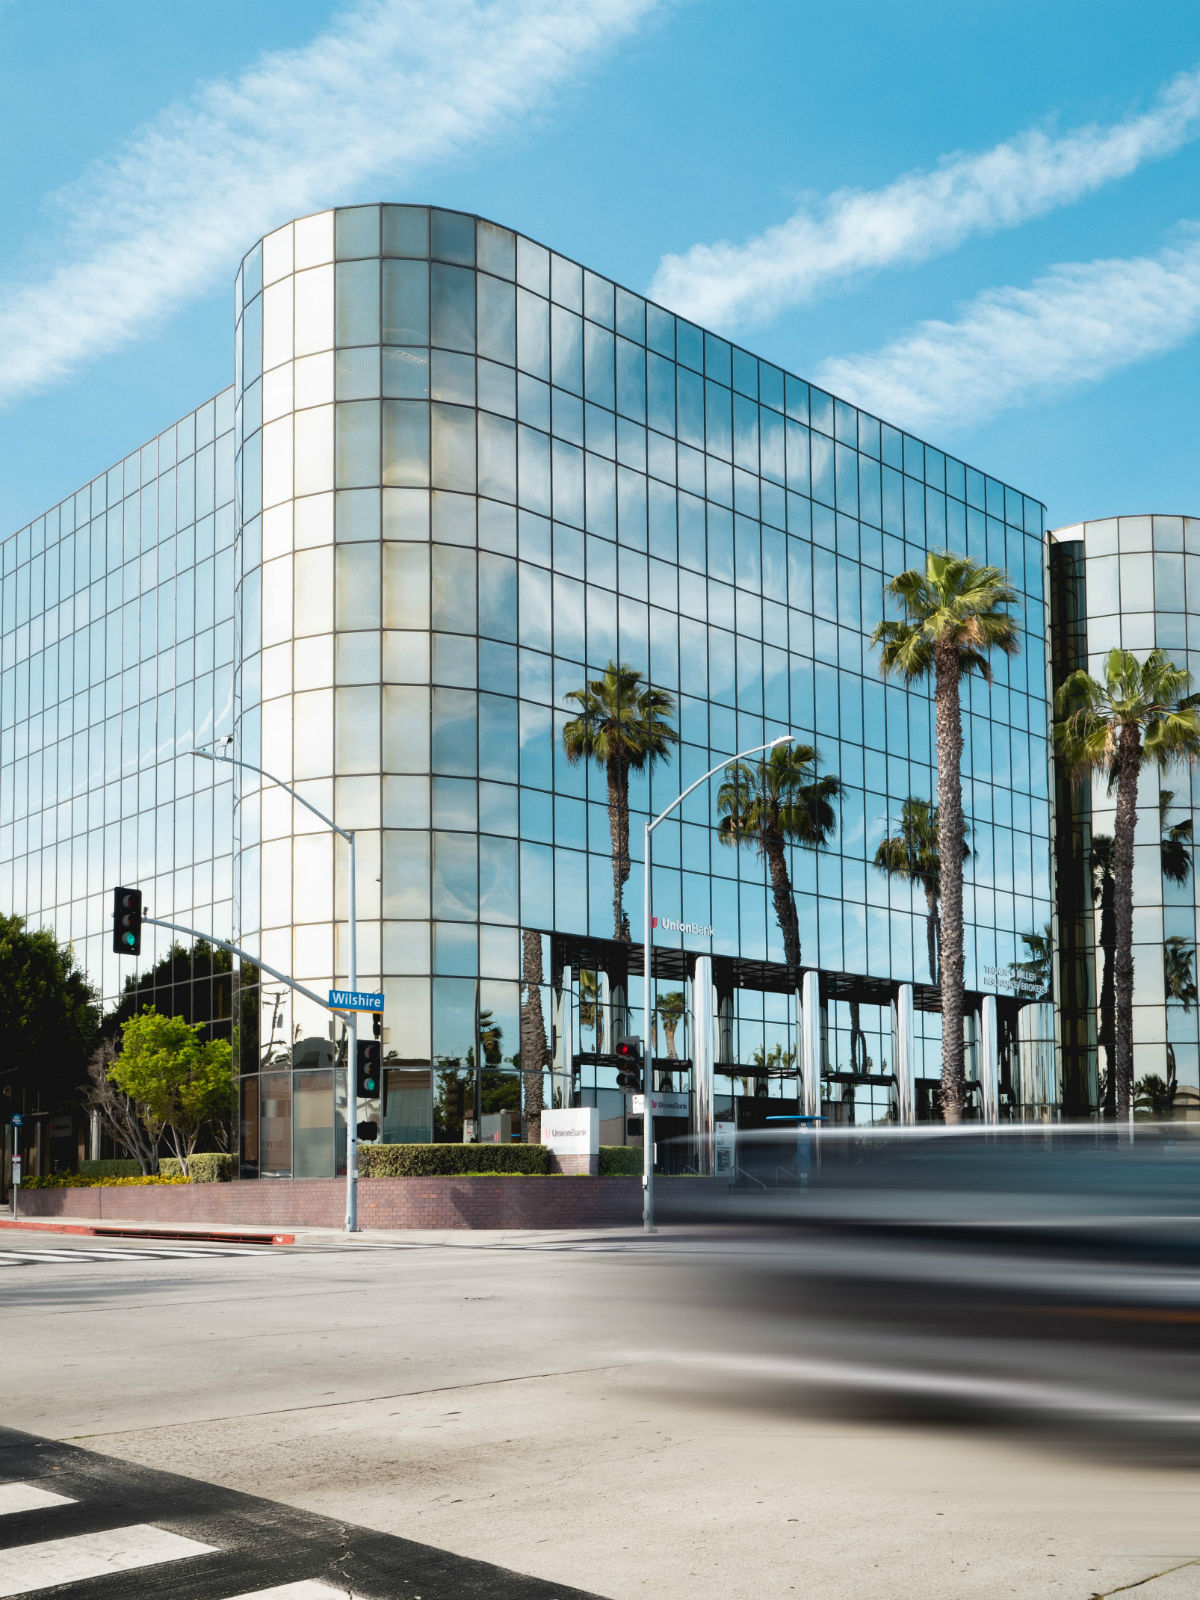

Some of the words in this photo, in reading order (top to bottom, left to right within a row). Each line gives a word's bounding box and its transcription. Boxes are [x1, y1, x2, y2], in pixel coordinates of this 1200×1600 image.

[661, 917, 714, 937] UnionBank
[1016, 970, 1037, 982] MILLER
[984, 977, 1018, 990] INSURANCE
[1020, 982, 1048, 994] BROKERS
[332, 992, 381, 1008] Wilshire
[658, 1101, 688, 1110] UnionBank
[551, 1128, 587, 1138] UnionBank
